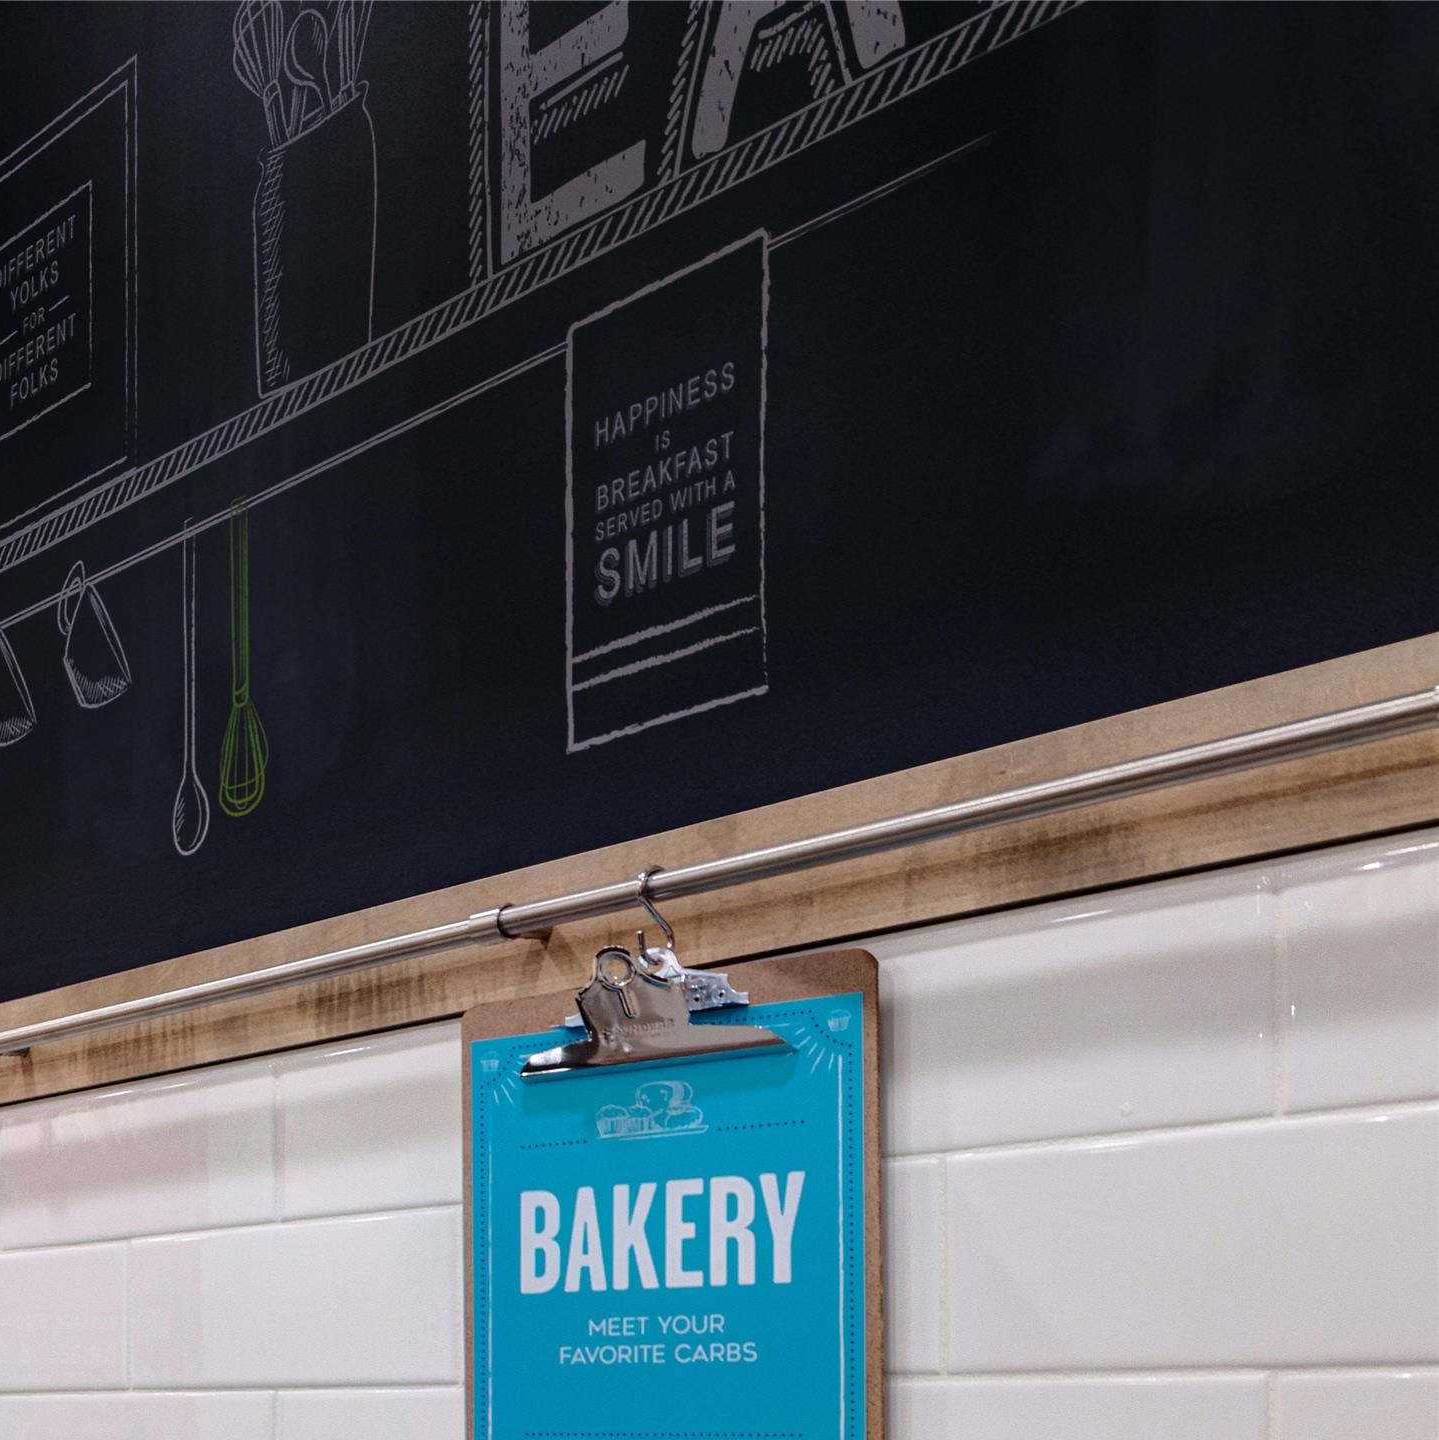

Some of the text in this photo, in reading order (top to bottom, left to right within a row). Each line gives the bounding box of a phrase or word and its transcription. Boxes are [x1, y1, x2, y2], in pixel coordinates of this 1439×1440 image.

[10, 260, 59, 312] YOLKS
[23, 307, 45, 335] FOR
[10, 358, 58, 410] FOLKS
[595, 361, 735, 449] HAPPINESS
[655, 430, 671, 453] IS
[595, 431, 734, 512] BREAKFAST
[595, 470, 736, 542] SERVED WITH A
[594, 501, 736, 606] SMILE
[520, 1171, 805, 1294] BAKERY
[588, 1314, 725, 1336] MEET YOUR
[559, 1342, 758, 1365] FAVORITE CARBS
